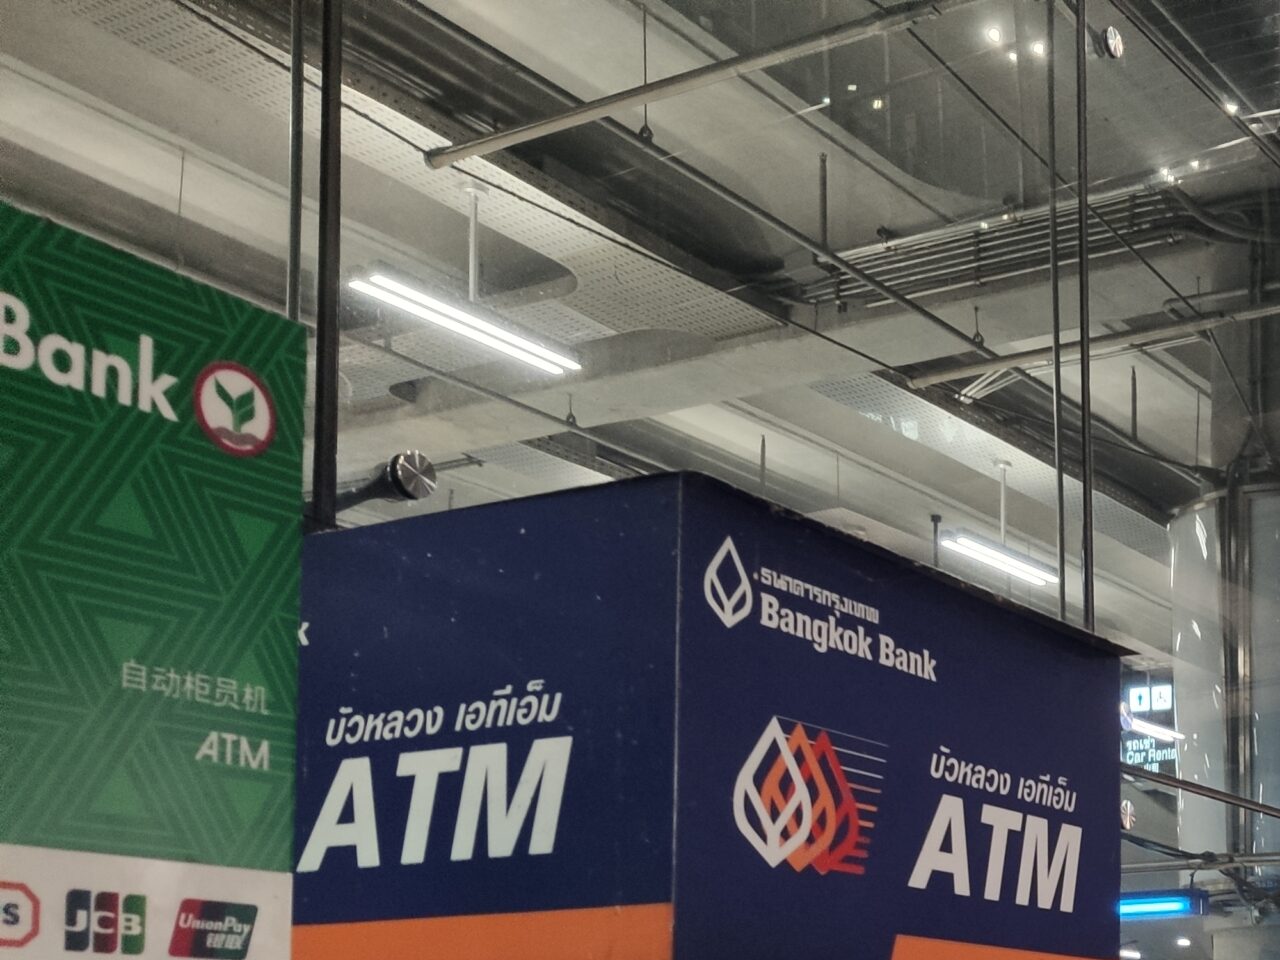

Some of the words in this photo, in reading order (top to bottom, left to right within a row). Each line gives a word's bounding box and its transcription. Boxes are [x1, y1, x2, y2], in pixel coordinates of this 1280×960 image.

[0, 291, 180, 423] Bank
[760, 592, 872, 662] Bangkok
[878, 633, 938, 682] Bank
[121, 659, 271, 716] 自动柜员机
[325, 706, 445, 747] บัวหลวง
[455, 679, 563, 732] เอทีเอ็ม
[195, 731, 271, 771] ATM
[929, 745, 1012, 796] บัวหลวง
[1017, 774, 1077, 813] เอทีเอ็ม
[1126, 750, 1147, 765] Car
[296, 735, 574, 874] ATM
[907, 793, 1083, 914] ATM
[64, 909, 143, 936] JCB
[178, 912, 252, 941] UnionPay
